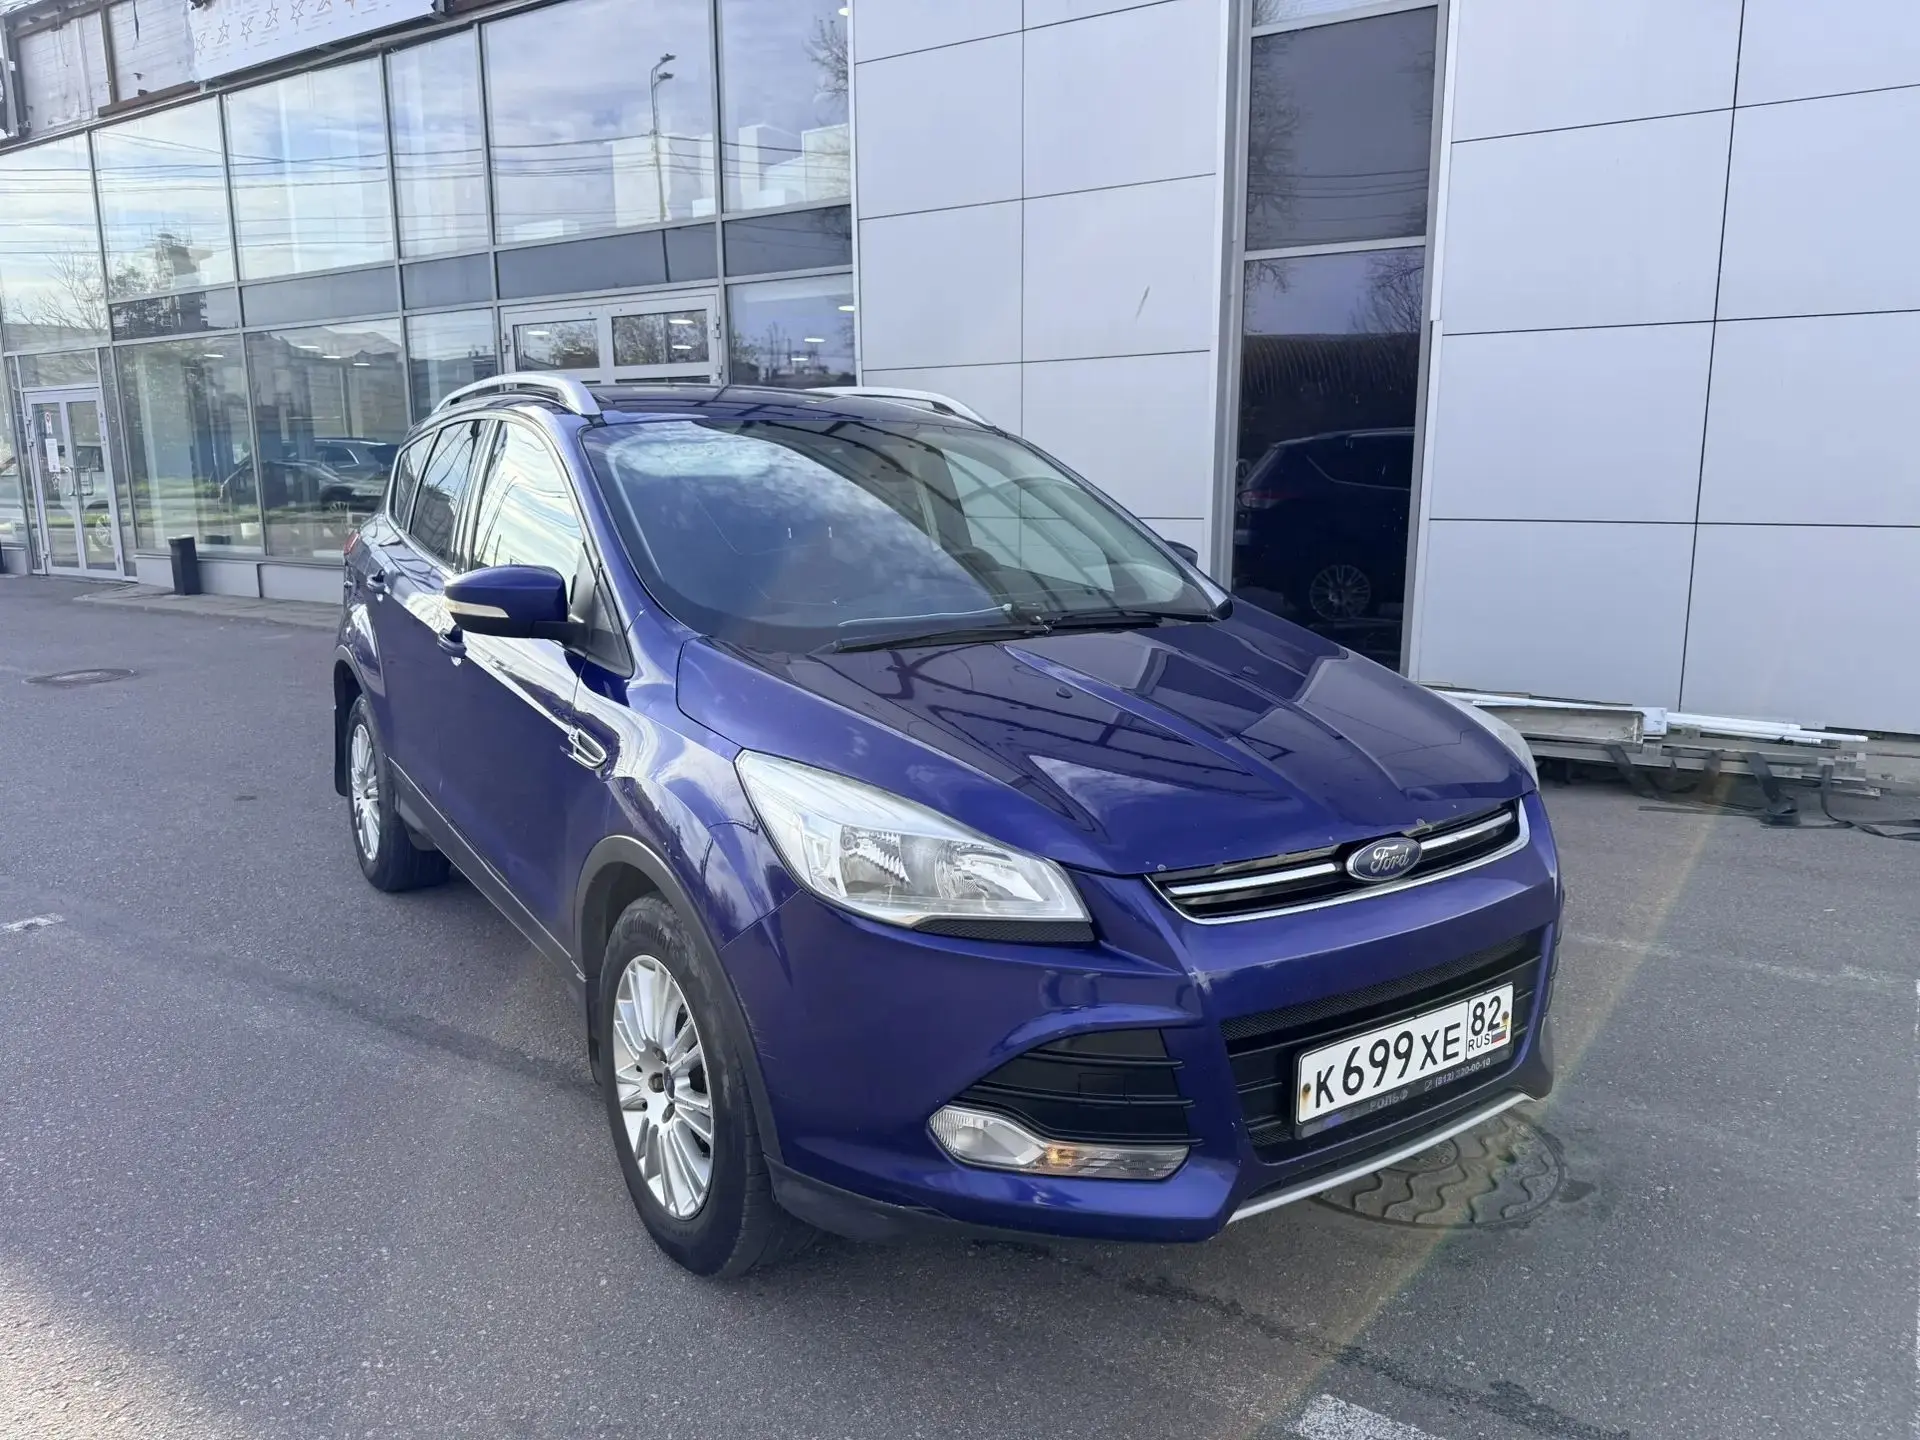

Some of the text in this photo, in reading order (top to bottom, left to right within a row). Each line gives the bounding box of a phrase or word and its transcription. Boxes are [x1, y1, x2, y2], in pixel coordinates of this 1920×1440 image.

[1370, 844, 1409, 873] Ford
[1471, 995, 1501, 1036] 82
[1468, 1034, 1491, 1052] RUS
